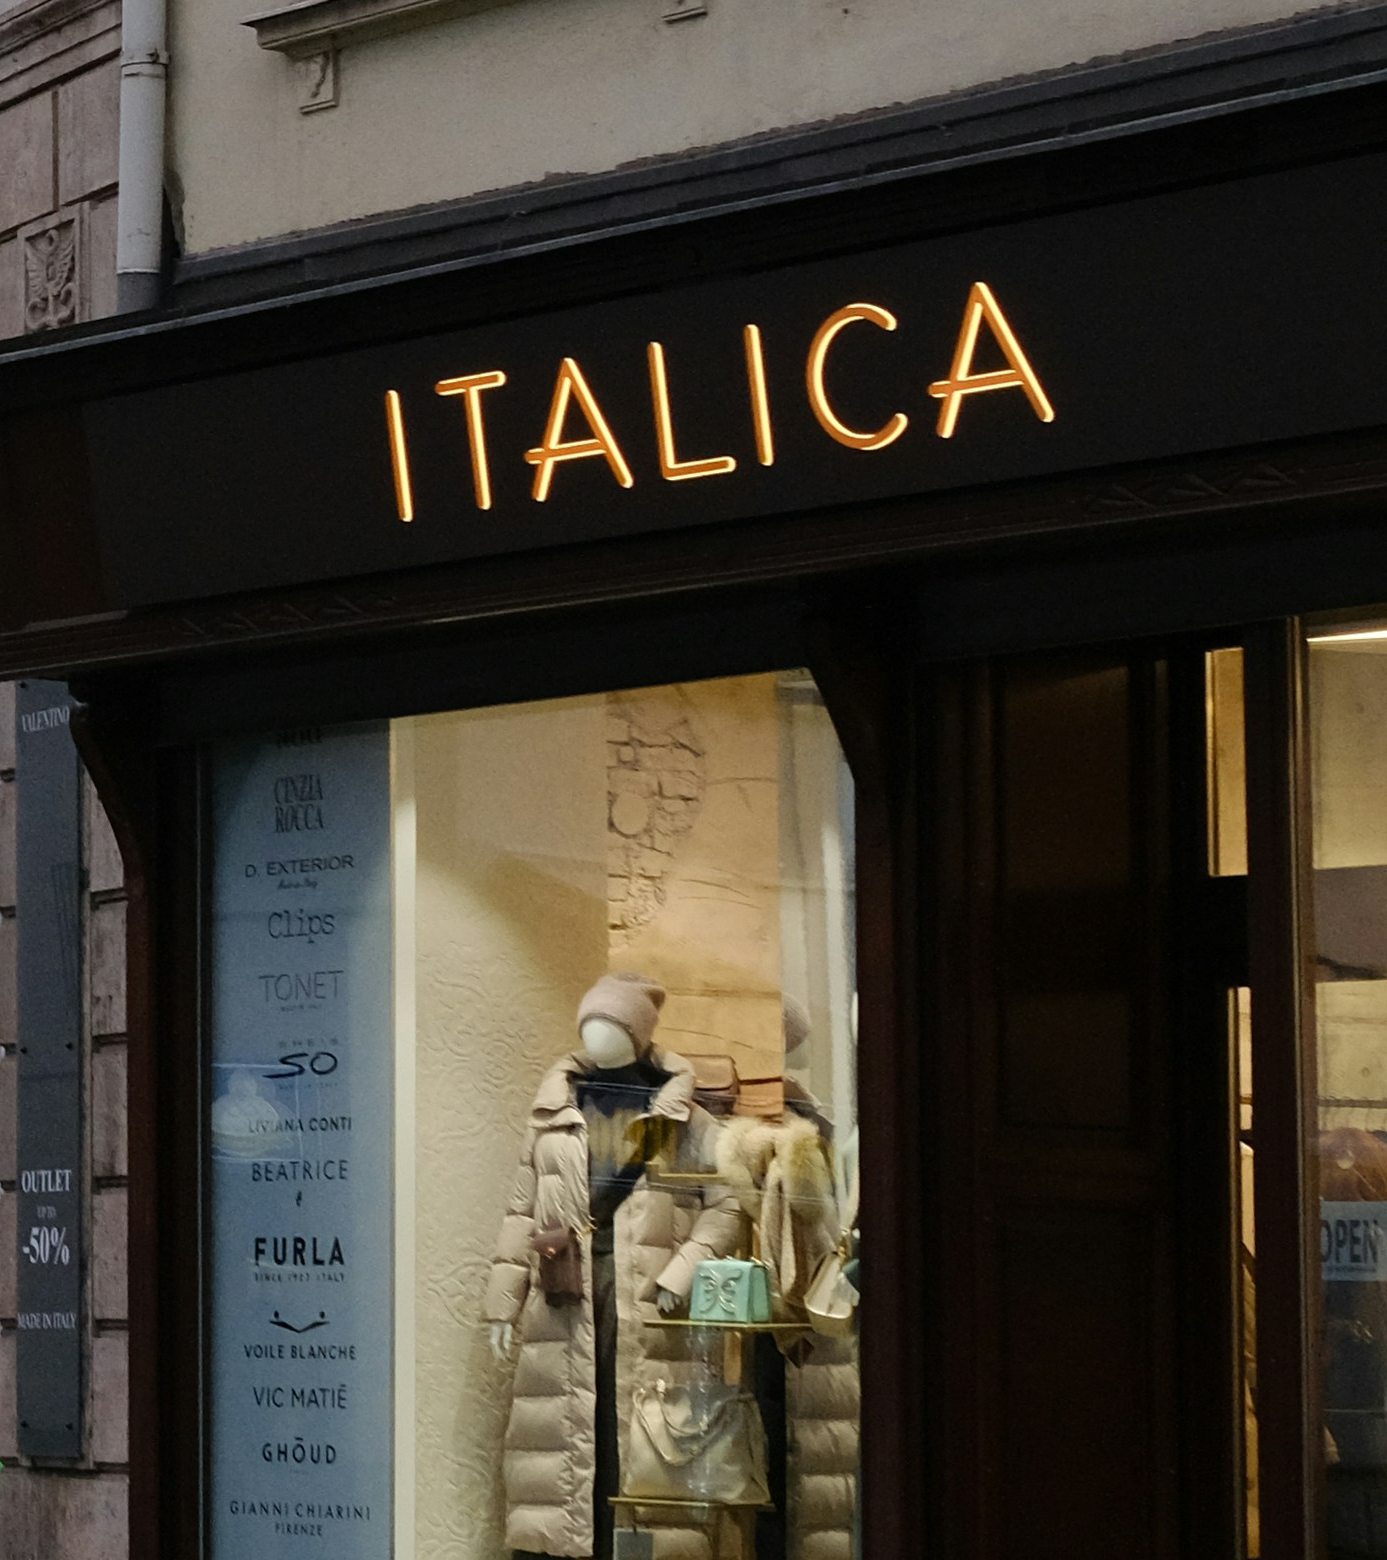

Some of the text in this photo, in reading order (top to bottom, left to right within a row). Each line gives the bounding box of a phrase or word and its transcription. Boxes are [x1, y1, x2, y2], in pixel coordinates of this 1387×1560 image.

[384, 282, 1054, 522] ITALICA
[21, 705, 71, 732] VALENTINO
[274, 775, 325, 804] CINZIA
[274, 803, 325, 833] ROCCA
[245, 854, 355, 878] D. EXTERIOR
[268, 908, 336, 943] Clips
[258, 970, 345, 1004] TONET
[263, 1051, 339, 1079] SO
[309, 1117, 352, 1131] CONTI
[21, 1169, 72, 1193] OUTLET
[251, 1160, 349, 1182] BEATRICE
[22, 1226, 70, 1266] -50%
[254, 1236, 345, 1267] FURLA
[1320, 1219, 1379, 1263] OPEN
[17, 1311, 77, 1329] MADE IN ITALY
[244, 1343, 357, 1360] VOILE BLANCHE
[252, 1386, 284, 1409] VIC
[230, 1500, 371, 1520] GIANNI CHIARINI
[274, 1523, 323, 1536] FIRENZE
